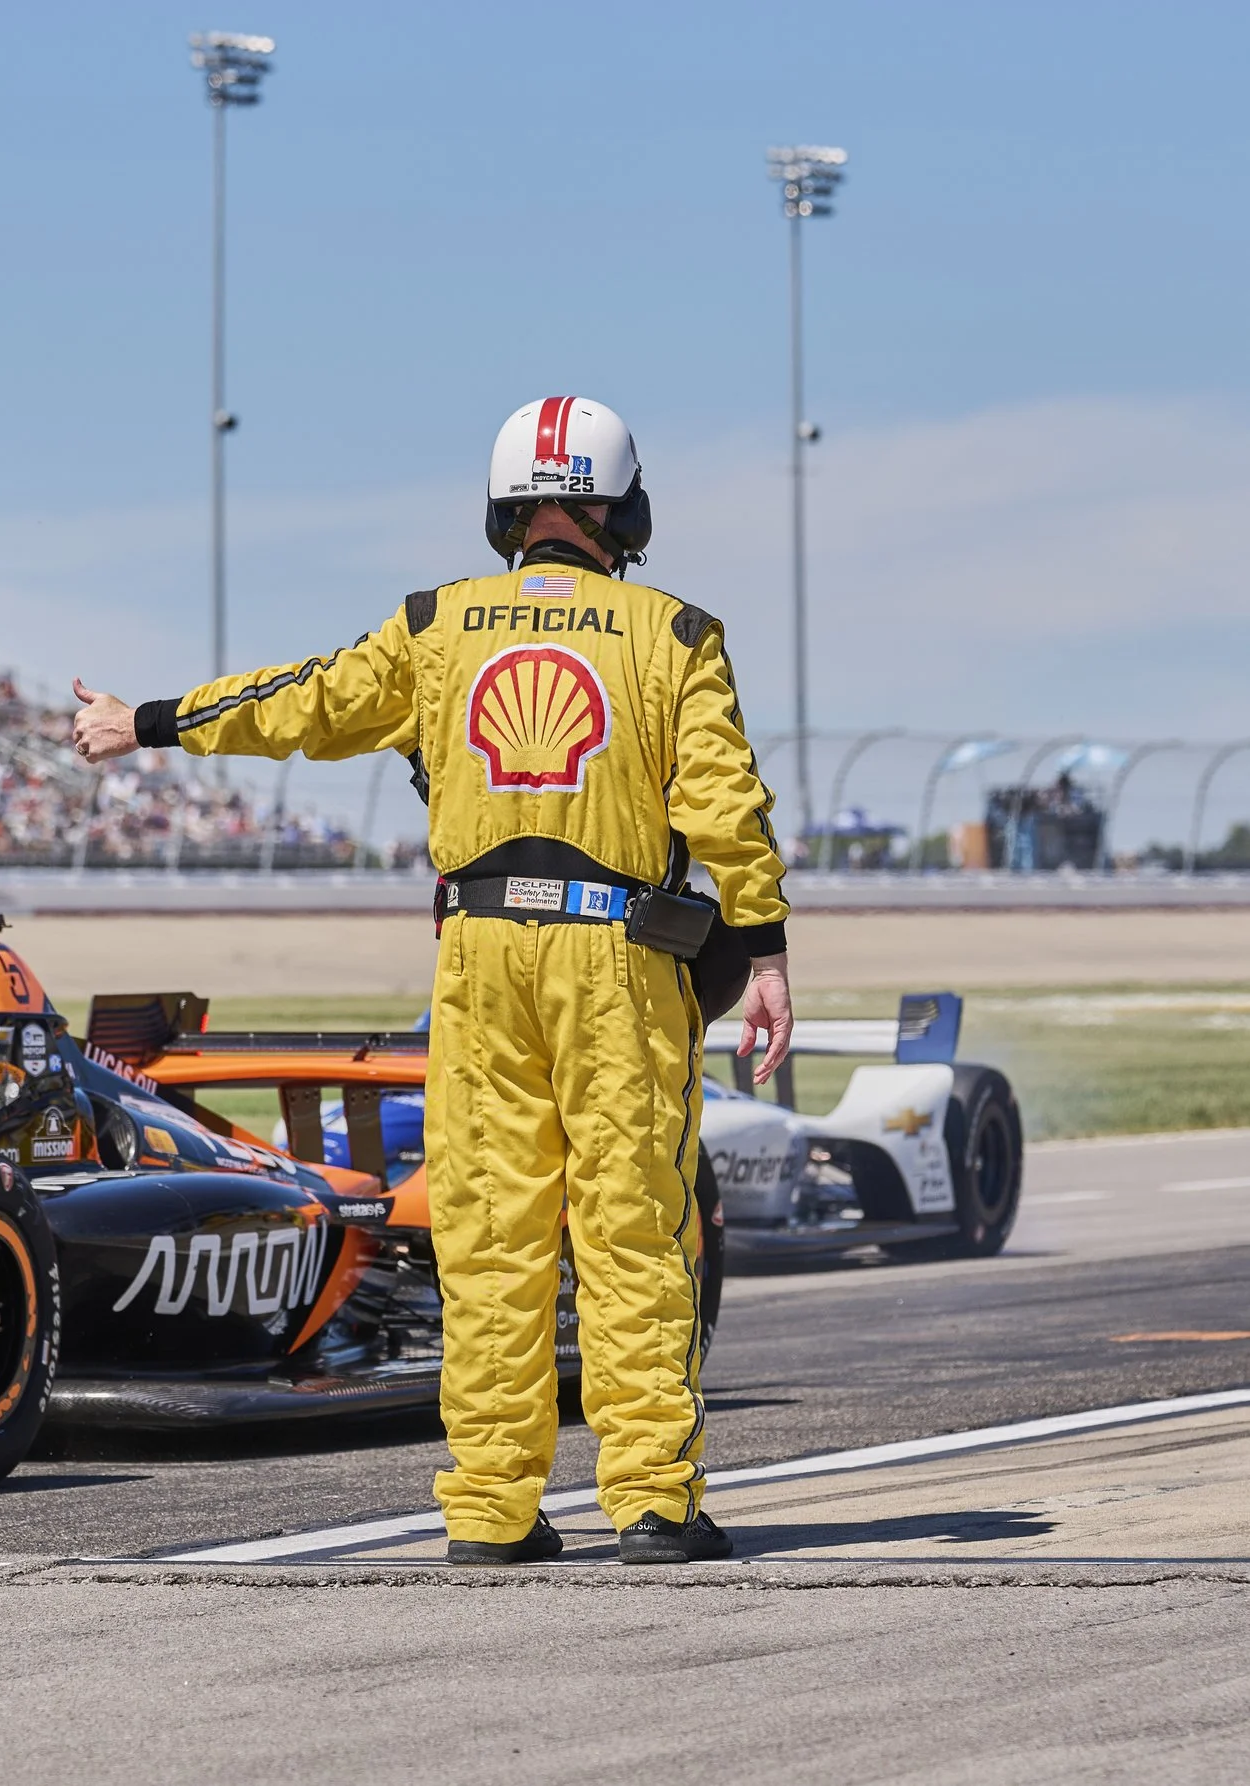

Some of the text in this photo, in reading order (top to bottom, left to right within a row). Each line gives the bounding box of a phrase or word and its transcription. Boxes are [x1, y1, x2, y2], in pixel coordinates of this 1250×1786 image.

[568, 476, 595, 493] 25
[463, 606, 625, 637] OFFICIAL
[510, 880, 561, 890] DELPHI
[518, 888, 560, 899] Safety Team
[112, 1215, 329, 1317] ARROW
[39, 1263, 62, 1414] Firestone
